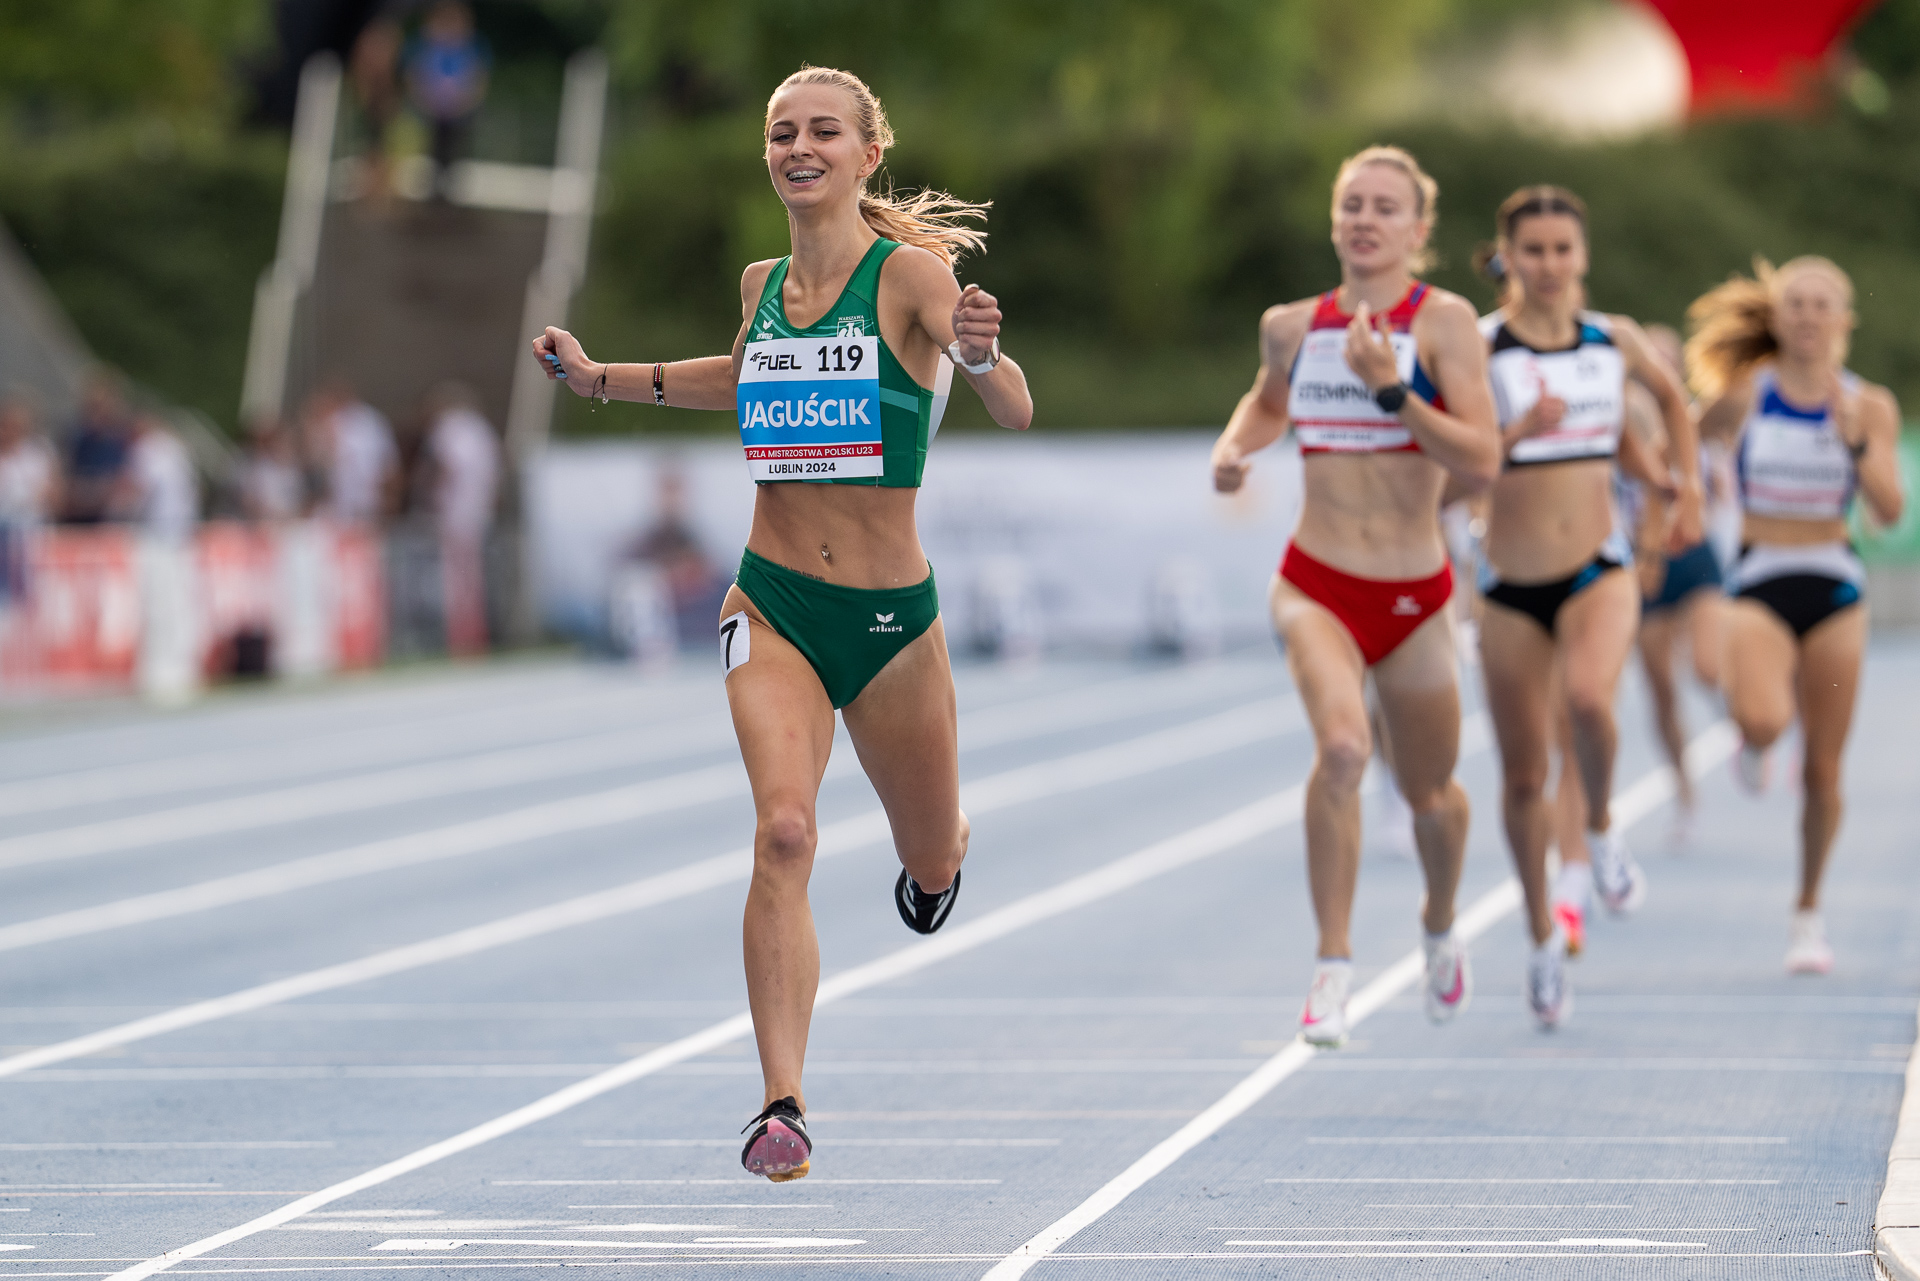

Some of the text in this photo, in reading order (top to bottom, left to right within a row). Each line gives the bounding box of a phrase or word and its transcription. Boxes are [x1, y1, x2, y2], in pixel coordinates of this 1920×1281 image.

[758, 354, 802, 371] FUEL
[817, 345, 863, 371] 119
[742, 392, 871, 429] JAGUŚCIK
[749, 450, 766, 458] PZLA
[768, 449, 823, 458] MISTRZOSTWA
[824, 447, 855, 456] POLSKI
[856, 446, 873, 454] U23
[769, 462, 836, 474] LUBLIN 2024
[720, 618, 738, 671] 7
